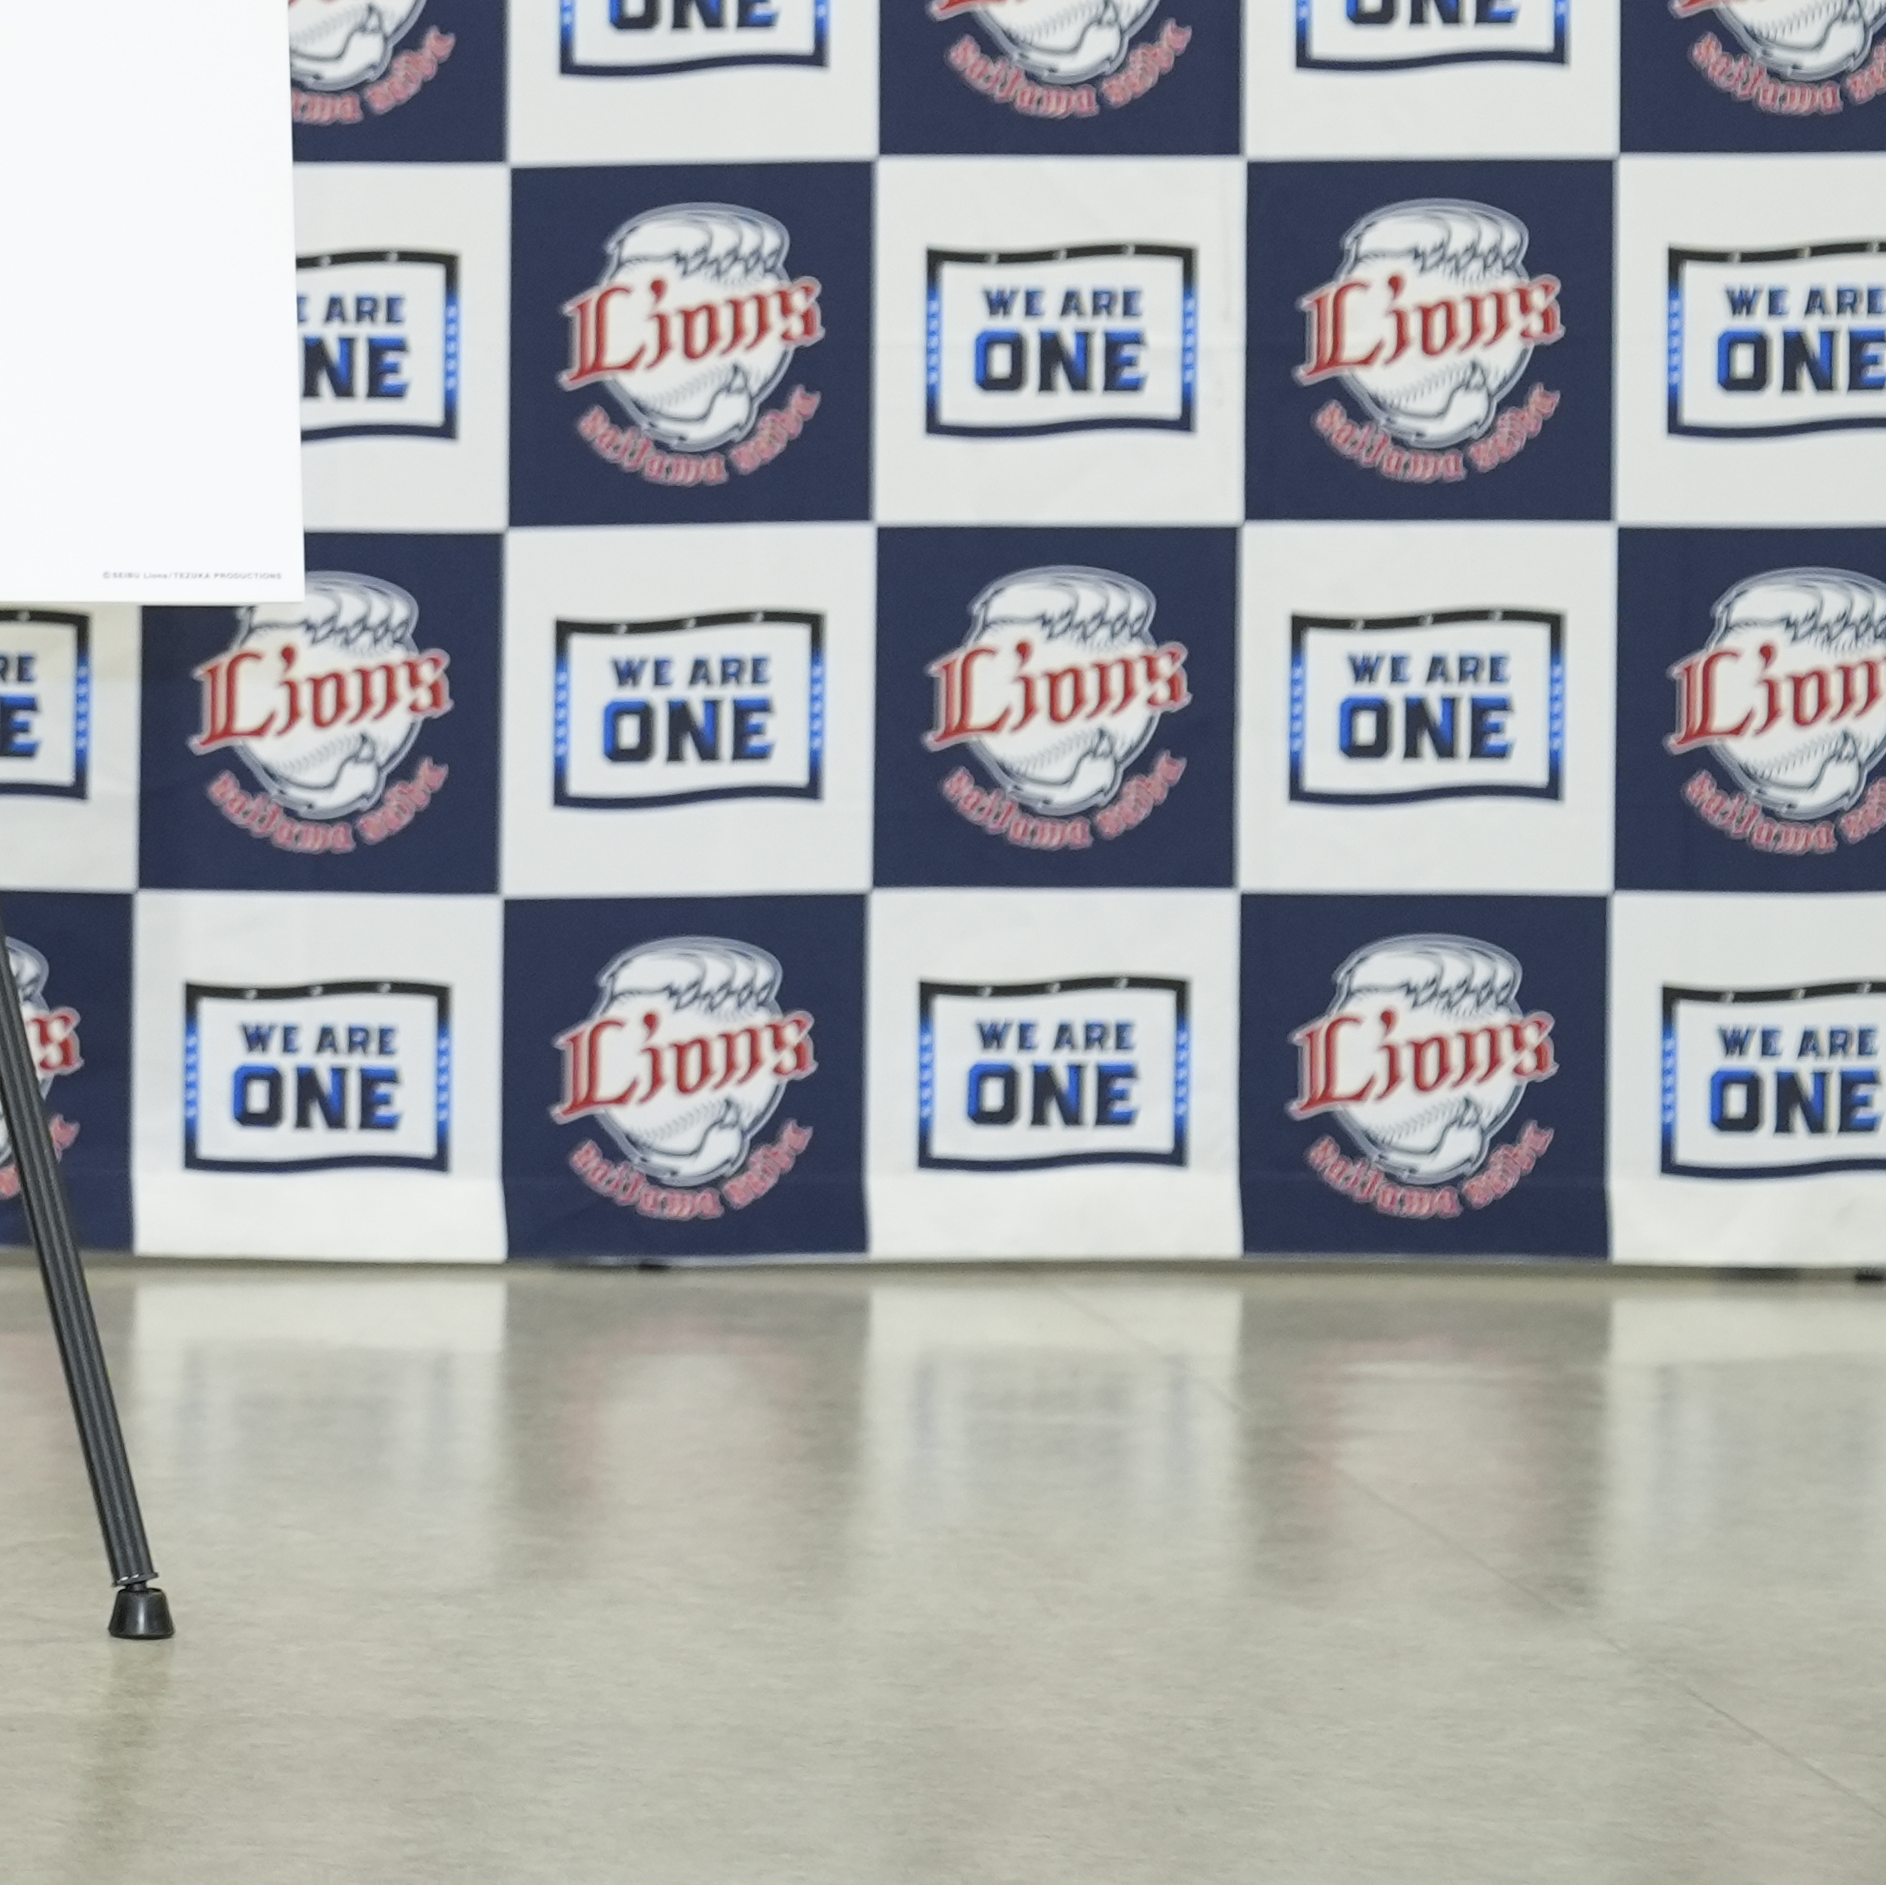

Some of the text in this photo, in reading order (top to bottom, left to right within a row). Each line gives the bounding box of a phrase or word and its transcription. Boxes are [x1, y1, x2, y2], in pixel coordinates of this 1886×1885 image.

[566, 278, 820, 383] Lions
[983, 289, 1141, 318] WE ARE
[1304, 274, 1560, 379] Lions
[974, 330, 1145, 393] ONE
[197, 644, 448, 748] Lions
[612, 656, 768, 687] WE ARE
[933, 640, 1186, 743] Lions
[1348, 655, 1508, 684] WE ARE
[603, 698, 773, 764] ONE
[1338, 696, 1513, 760] ONE
[240, 1024, 395, 1056] WE ARE
[558, 1011, 813, 1117] Lions
[976, 1022, 1133, 1052] WE ARE
[1297, 1008, 1553, 1113] Lions
[1718, 1027, 1877, 1059] WE ARE
[232, 1064, 400, 1131] ONE
[966, 1062, 1138, 1127] ONE
[1709, 1069, 1881, 1135] ONE
